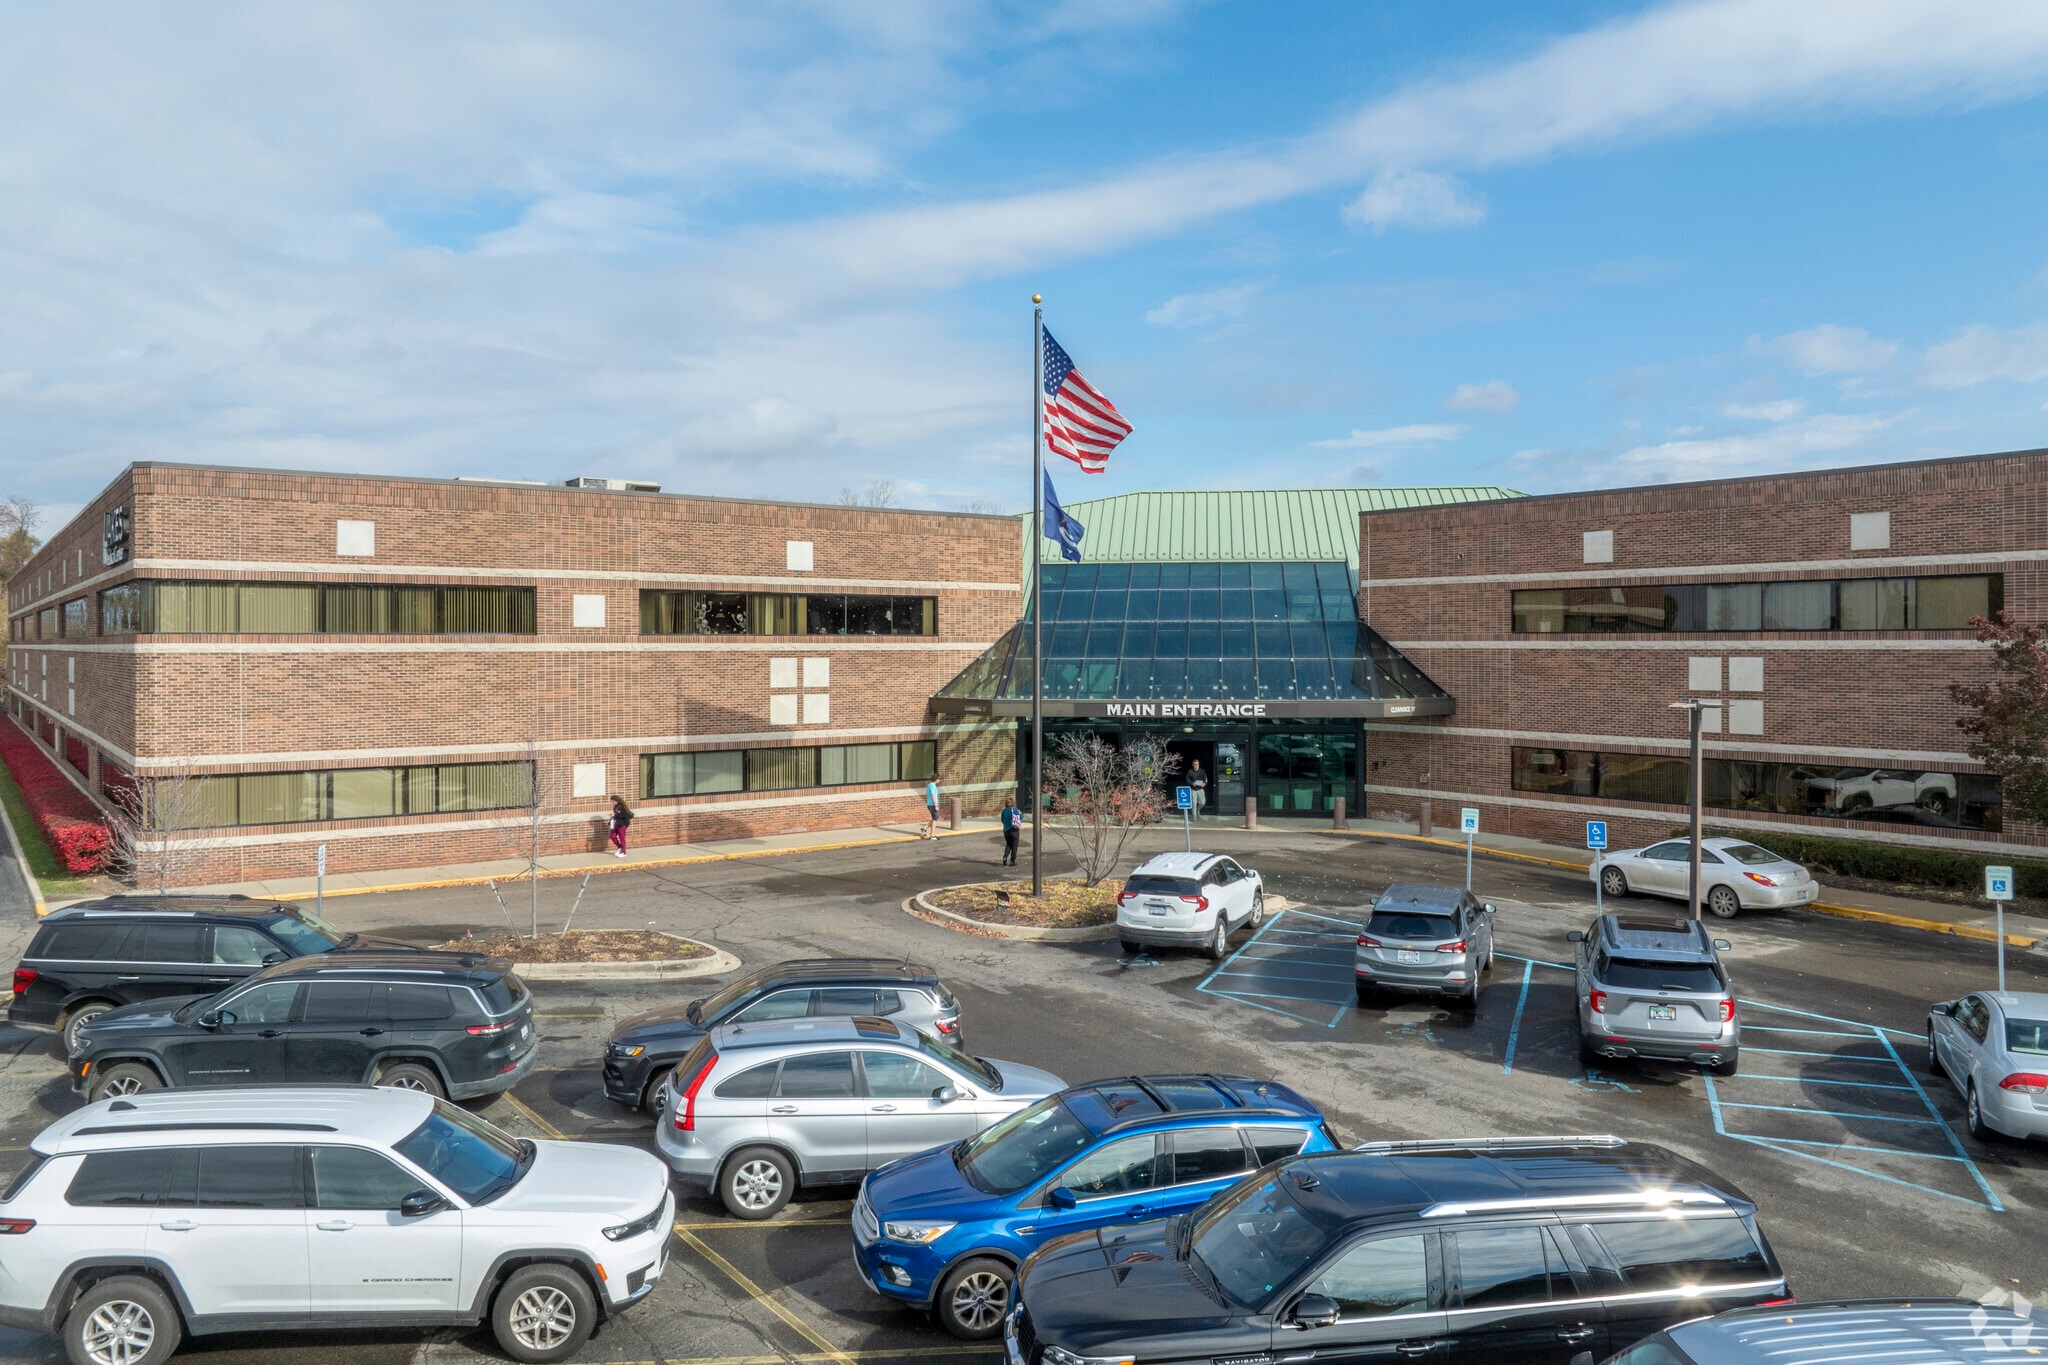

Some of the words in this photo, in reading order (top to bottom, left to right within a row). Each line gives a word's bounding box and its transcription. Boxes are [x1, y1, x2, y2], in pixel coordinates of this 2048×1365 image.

[1106, 704, 1156, 716] MAIN
[1161, 704, 1266, 716] ENTRANCE
[1224, 1357, 1270, 1365] NAVIGATOR
